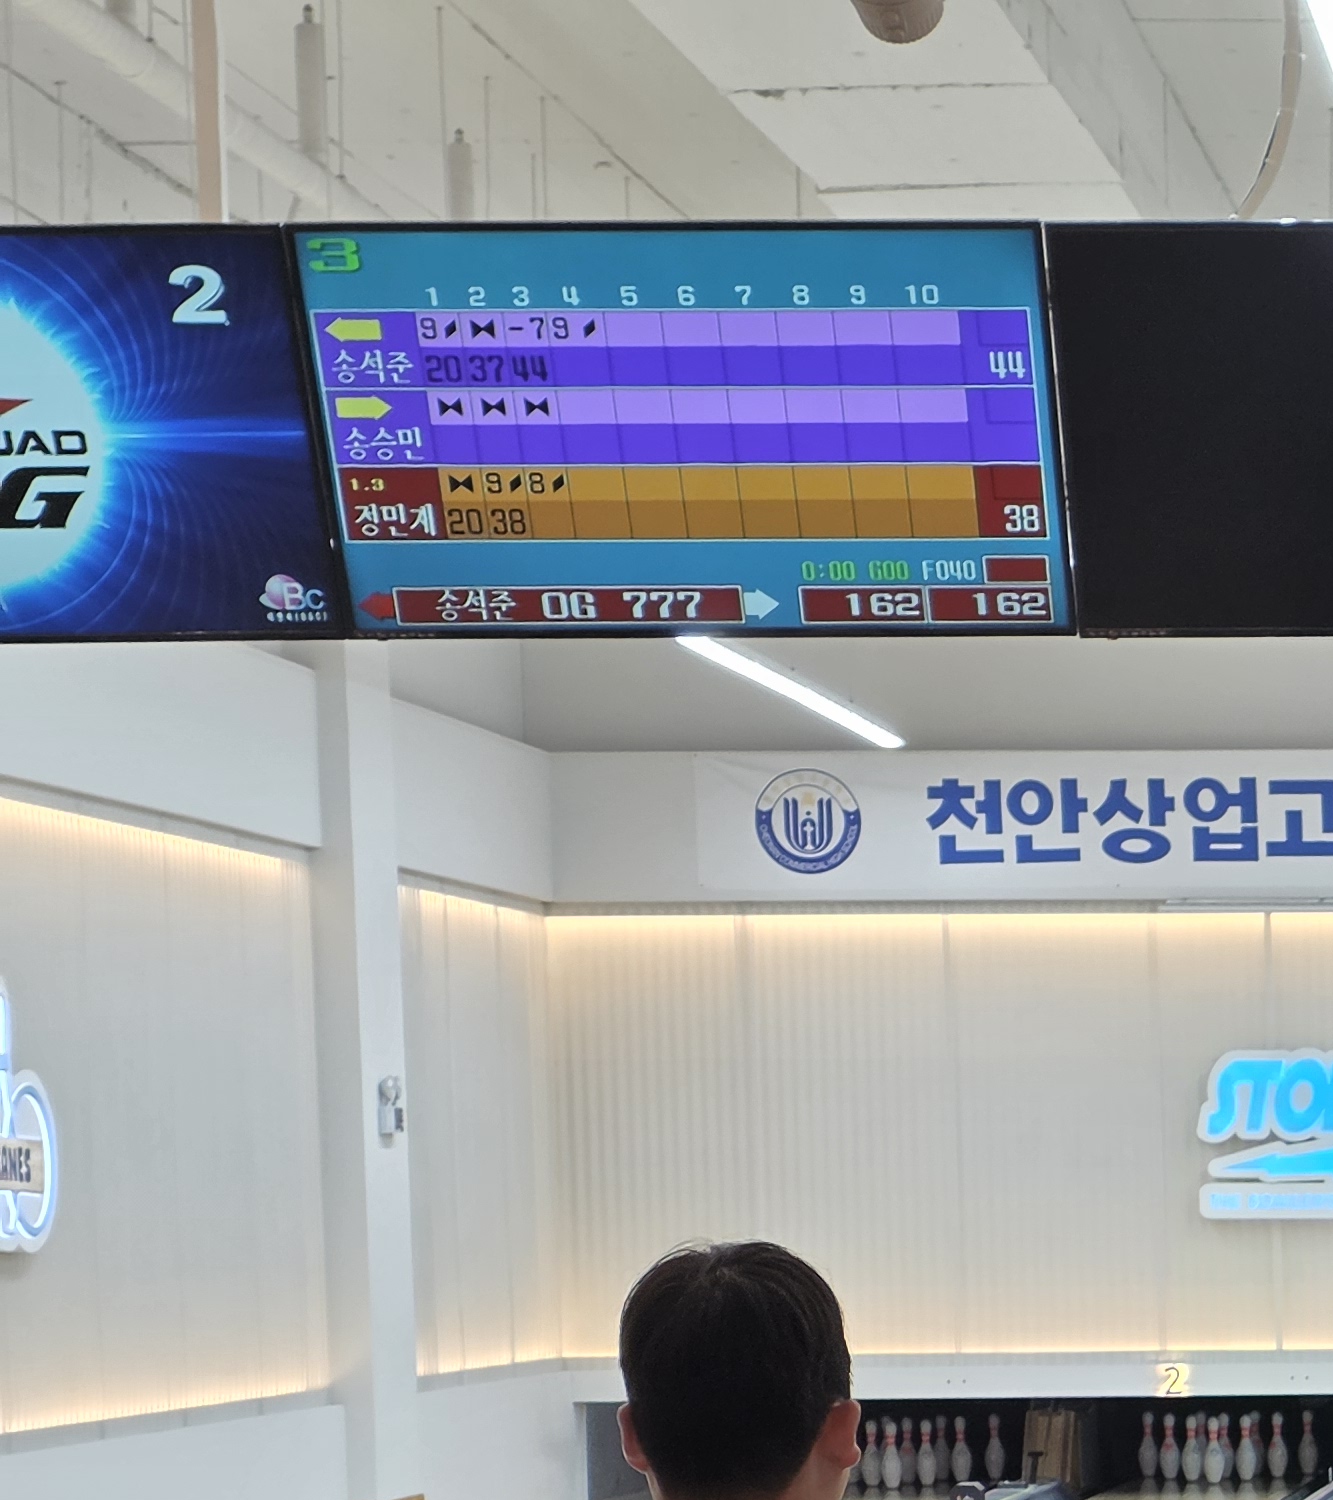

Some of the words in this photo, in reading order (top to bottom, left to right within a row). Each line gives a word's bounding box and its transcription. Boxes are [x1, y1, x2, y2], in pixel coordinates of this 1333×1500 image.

[306, 238, 362, 272] 3
[168, 264, 229, 326] 2
[425, 286, 439, 306] 1
[468, 286, 487, 307] 2
[511, 286, 530, 307] 3
[562, 286, 580, 306] 4
[620, 285, 638, 306] 5
[676, 285, 696, 306] 6
[734, 285, 752, 306] 7
[792, 285, 810, 305] 8
[849, 285, 867, 305] 9
[904, 284, 940, 305] 10
[331, 349, 415, 384] 송석준
[425, 355, 463, 383] 20
[468, 355, 505, 383] 37
[511, 355, 549, 383] 44
[988, 350, 1027, 380] 44
[343, 426, 425, 462] 송승민
[349, 477, 386, 492] 1.3
[446, 508, 484, 536] 20
[489, 508, 527, 536] 38
[1003, 503, 1041, 534] 38
[435, 588, 517, 622] 송석준
[622, 589, 702, 620] 777
[845, 592, 921, 617] 162
[971, 592, 1048, 617] 162
[1163, 1366, 1188, 1397] 2
